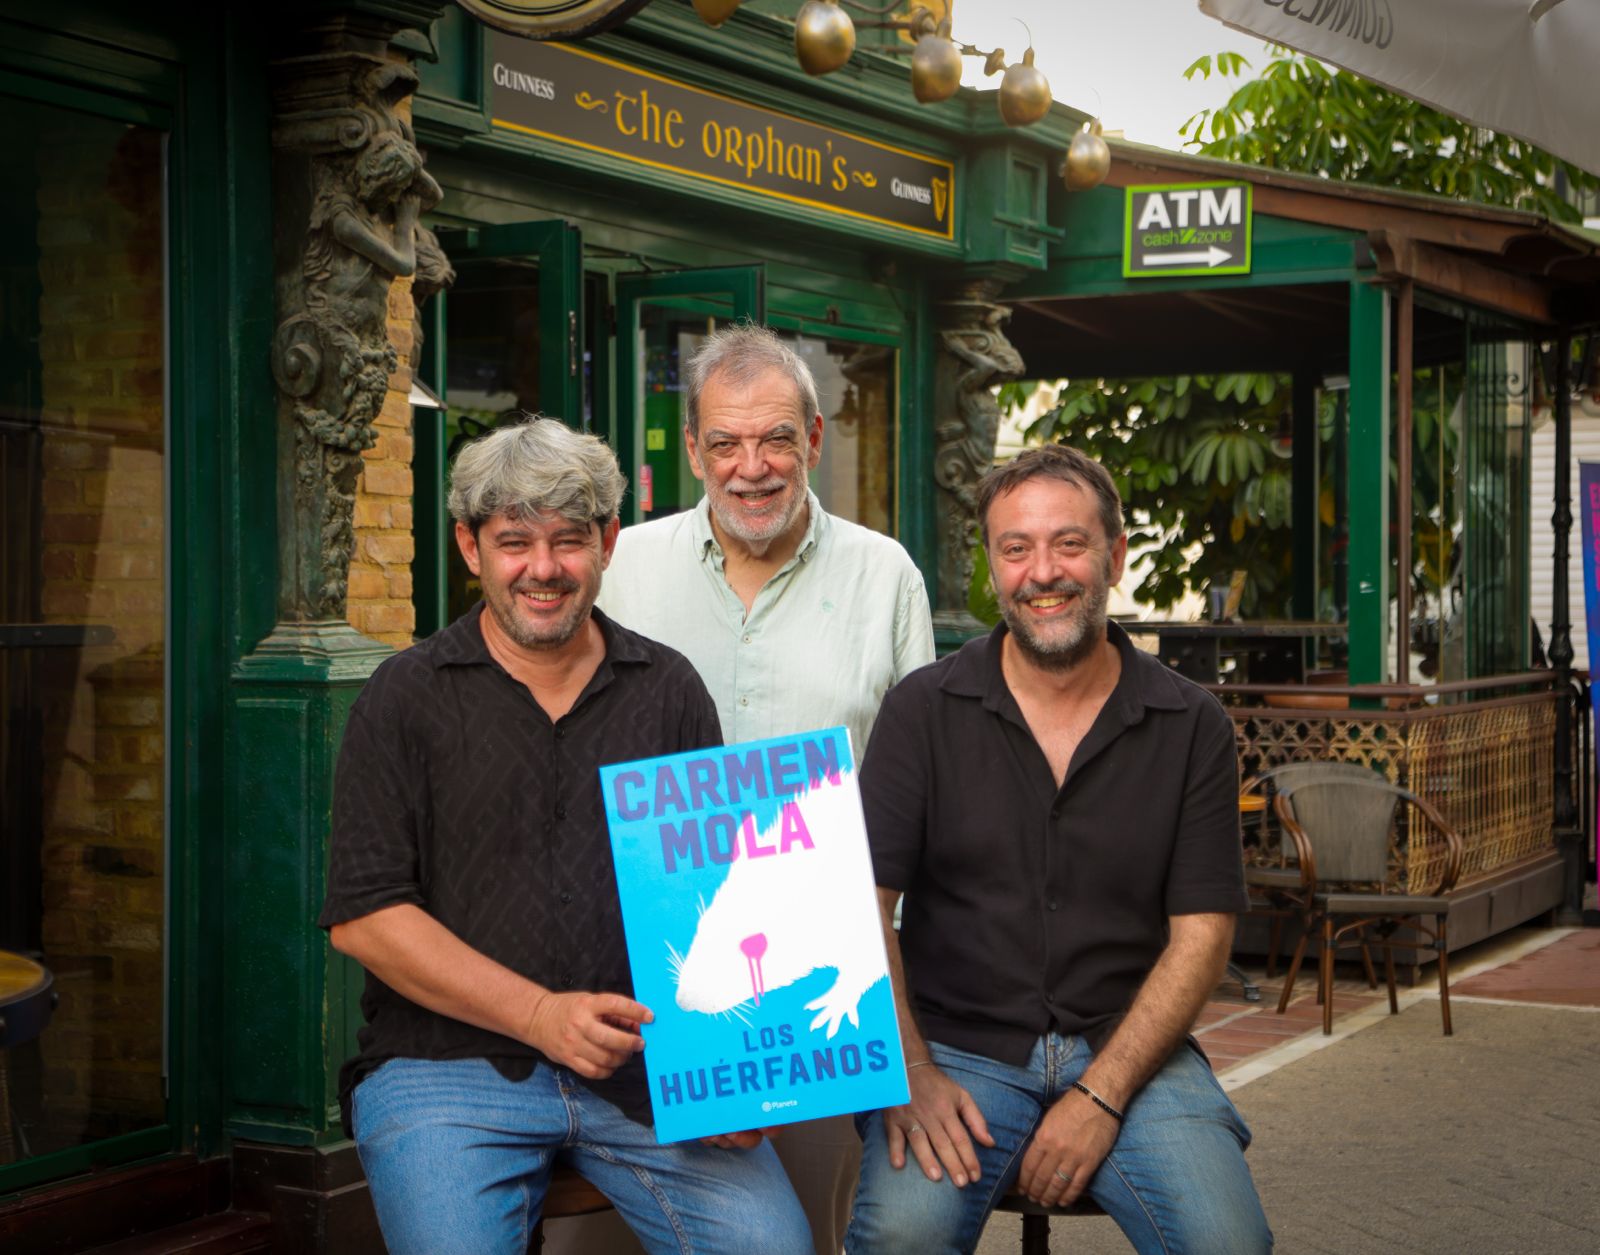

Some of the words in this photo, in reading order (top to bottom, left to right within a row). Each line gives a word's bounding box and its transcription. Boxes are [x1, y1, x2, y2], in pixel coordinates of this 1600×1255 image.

[493, 62, 555, 100] GUINNESS
[614, 90, 685, 149] The
[890, 177, 932, 205] GUINNESS
[1137, 187, 1242, 230] ATM
[613, 736, 842, 822] CARMEN
[659, 801, 816, 874] MOLA
[743, 1023, 795, 1053] LOS
[659, 1039, 889, 1107] HUÉRFANOS
[771, 1100, 798, 1109] Planeta
